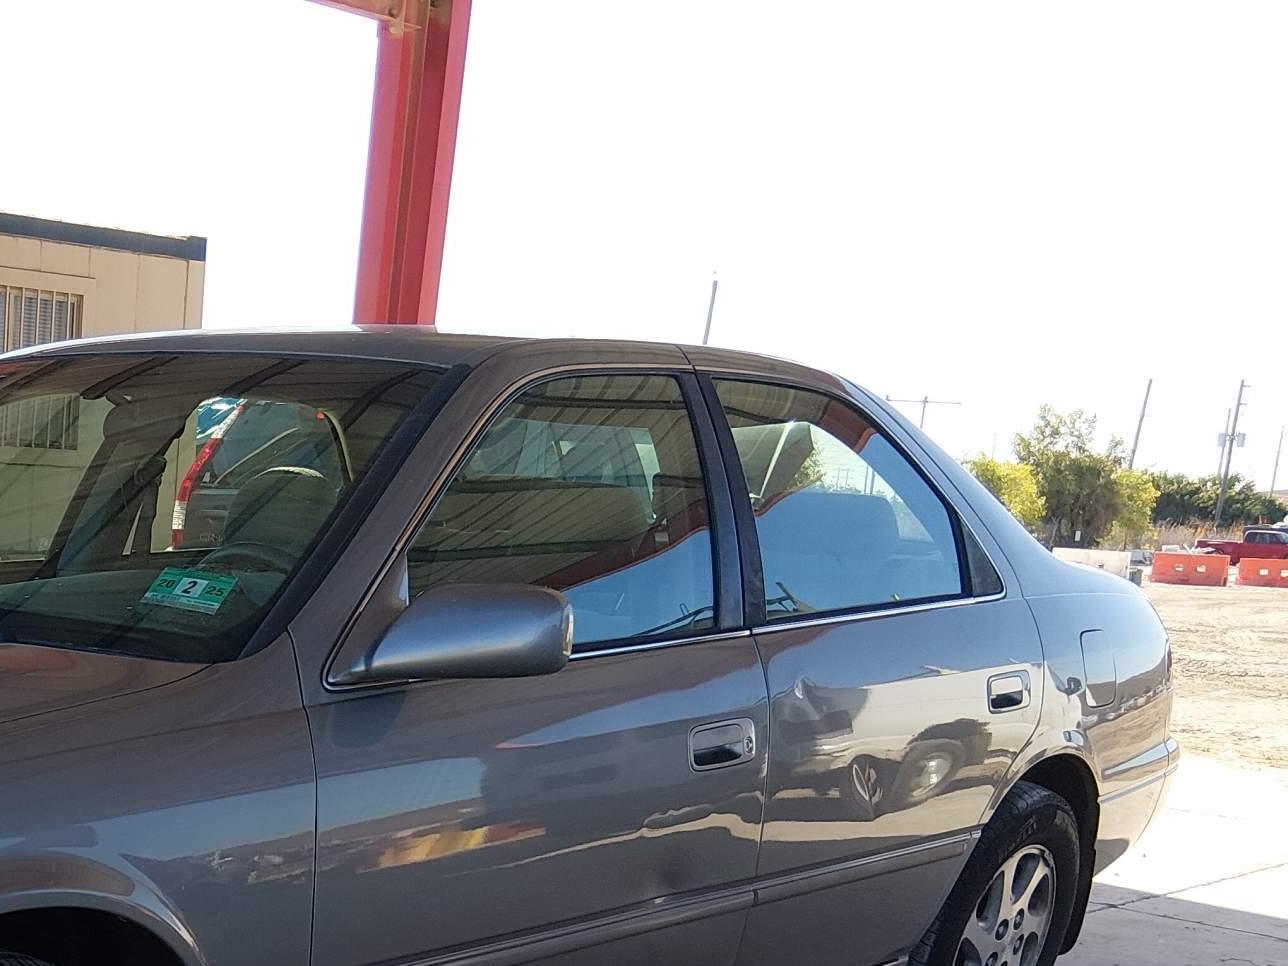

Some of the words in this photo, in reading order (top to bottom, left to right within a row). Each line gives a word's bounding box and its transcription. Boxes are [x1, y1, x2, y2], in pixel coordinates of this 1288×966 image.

[157, 578, 175, 588] 20
[181, 580, 198, 595] 2
[206, 585, 224, 597] 25
